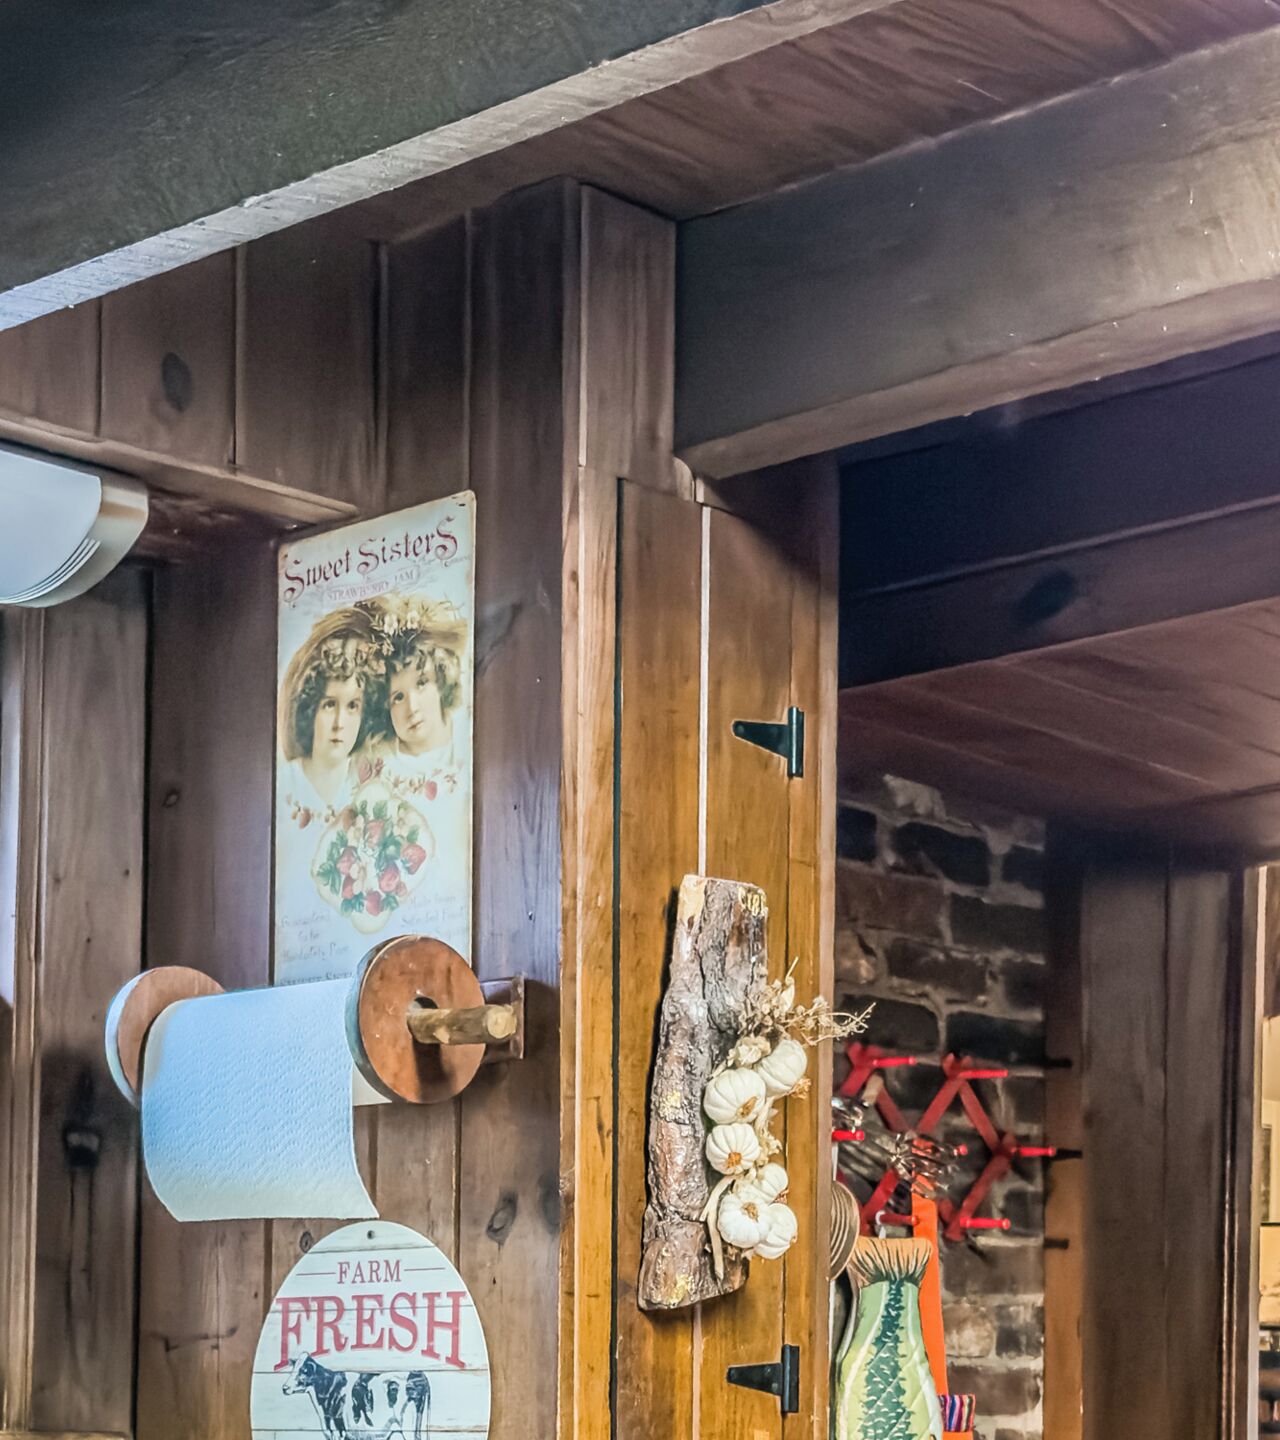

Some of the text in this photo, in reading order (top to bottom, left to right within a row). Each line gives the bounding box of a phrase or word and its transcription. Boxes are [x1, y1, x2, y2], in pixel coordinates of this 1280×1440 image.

[284, 549, 351, 608] Sweet
[337, 1259, 402, 1286] FARM
[273, 1290, 467, 1371] FRESH
